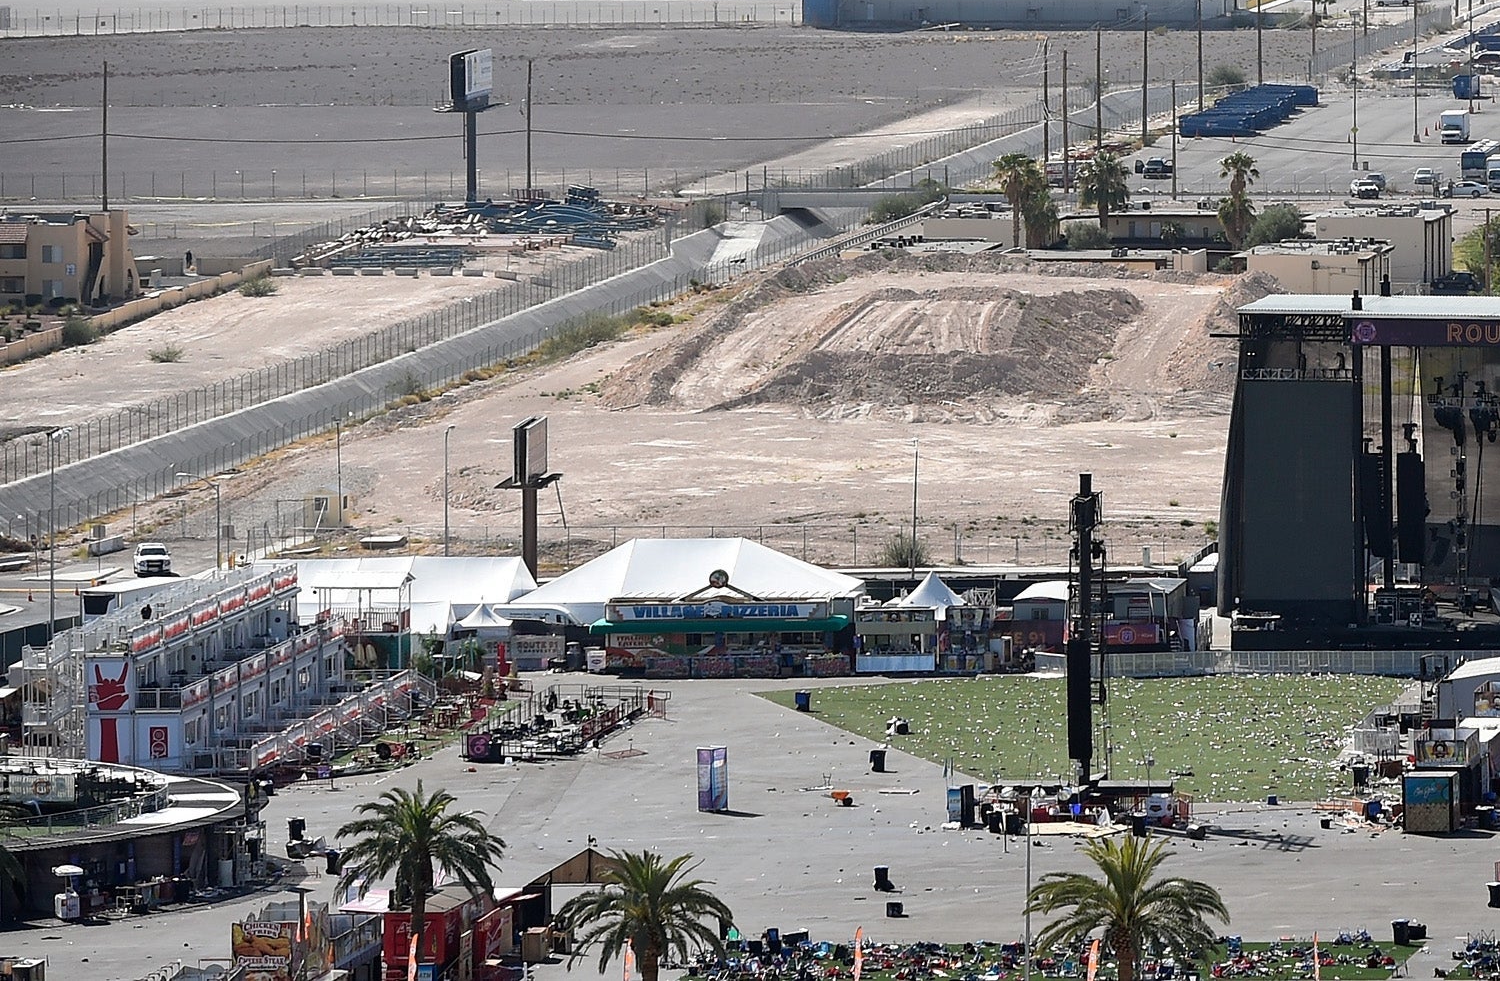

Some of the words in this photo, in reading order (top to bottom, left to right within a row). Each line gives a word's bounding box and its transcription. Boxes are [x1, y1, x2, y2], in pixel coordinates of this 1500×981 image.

[632, 605, 705, 618] VILLAGE
[720, 604, 800, 618] PIZZERIA
[243, 922, 280, 932] CHICKEN
[246, 929, 278, 938] STRIPS
[238, 956, 264, 966] CHEESE
[264, 956, 286, 966] STEAK
